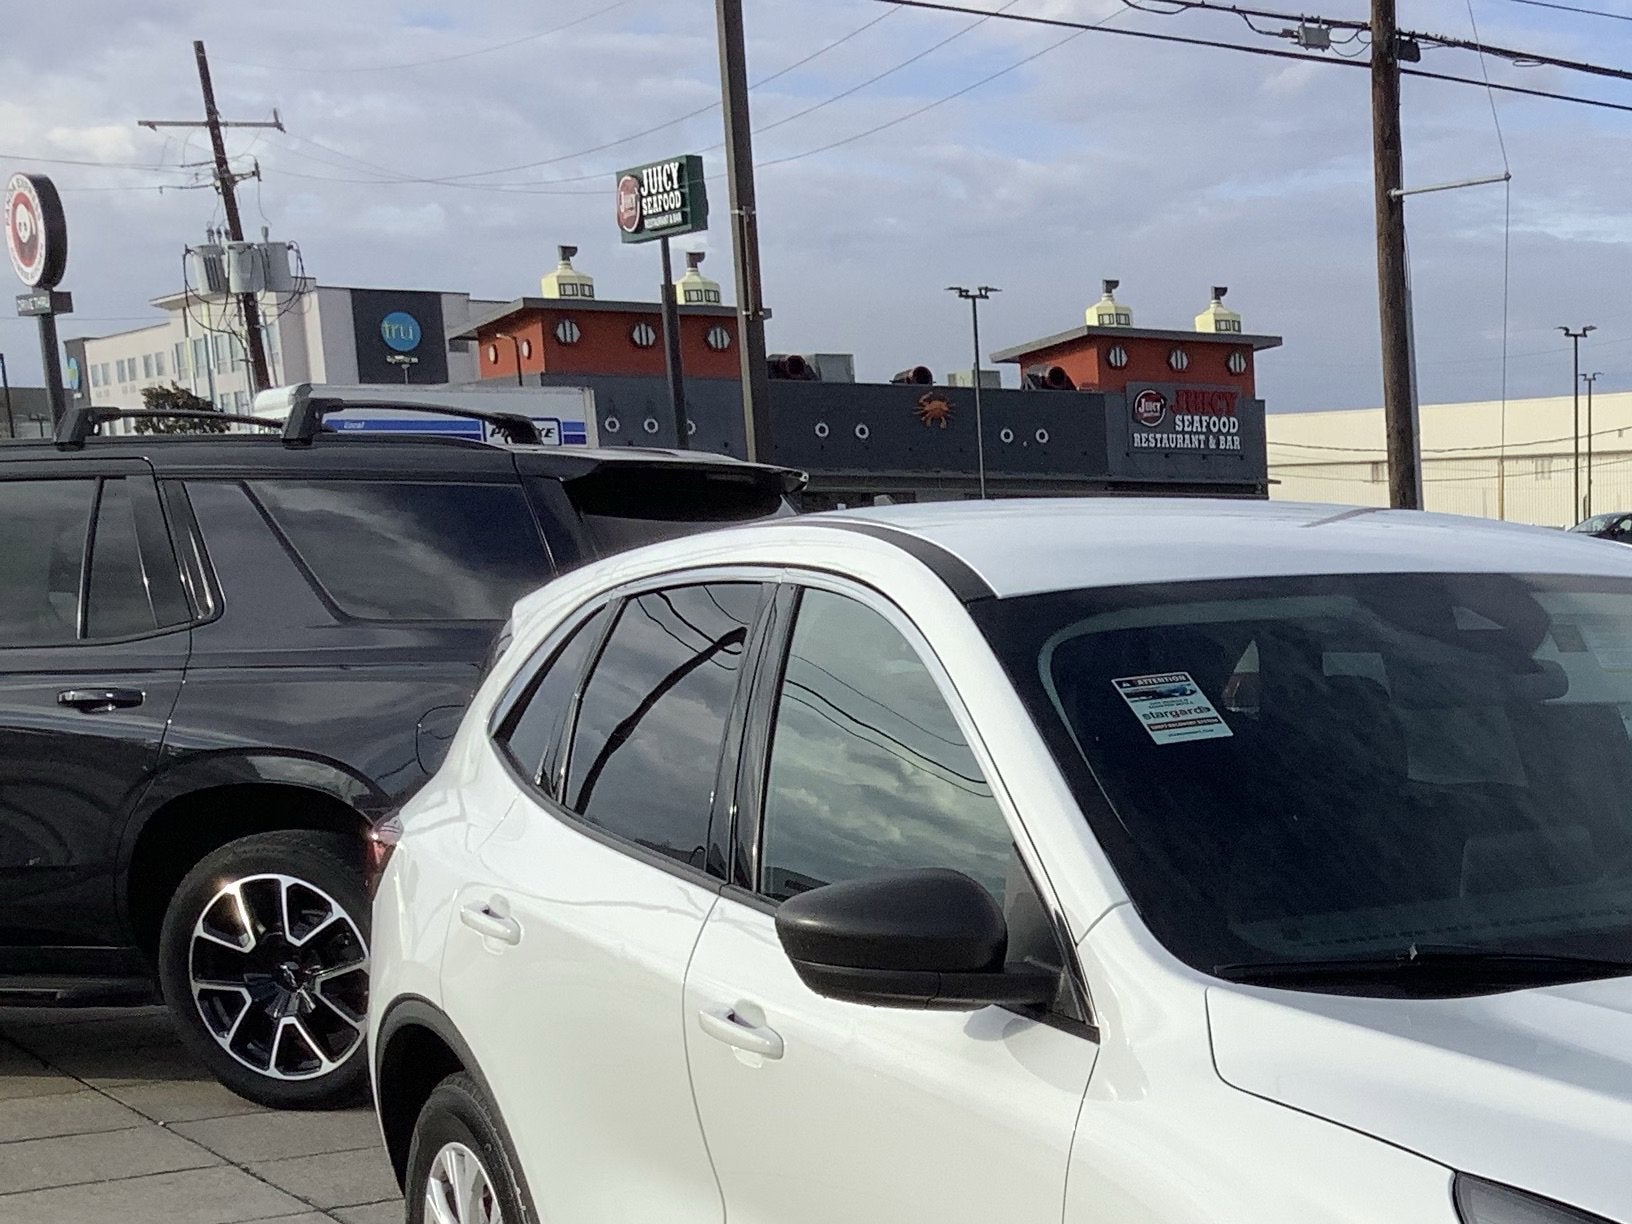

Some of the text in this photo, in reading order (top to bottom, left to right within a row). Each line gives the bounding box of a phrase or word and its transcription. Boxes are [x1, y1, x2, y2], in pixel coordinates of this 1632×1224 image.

[641, 162, 679, 196] JUICY
[642, 190, 682, 216] SEAFOOD
[383, 321, 413, 340] tru
[1169, 389, 1238, 416] JUICY
[1175, 414, 1239, 433] SEAFOOD
[1133, 433, 1241, 450] RESTAURANT & BAR
[1136, 674, 1187, 686] ATTENTION
